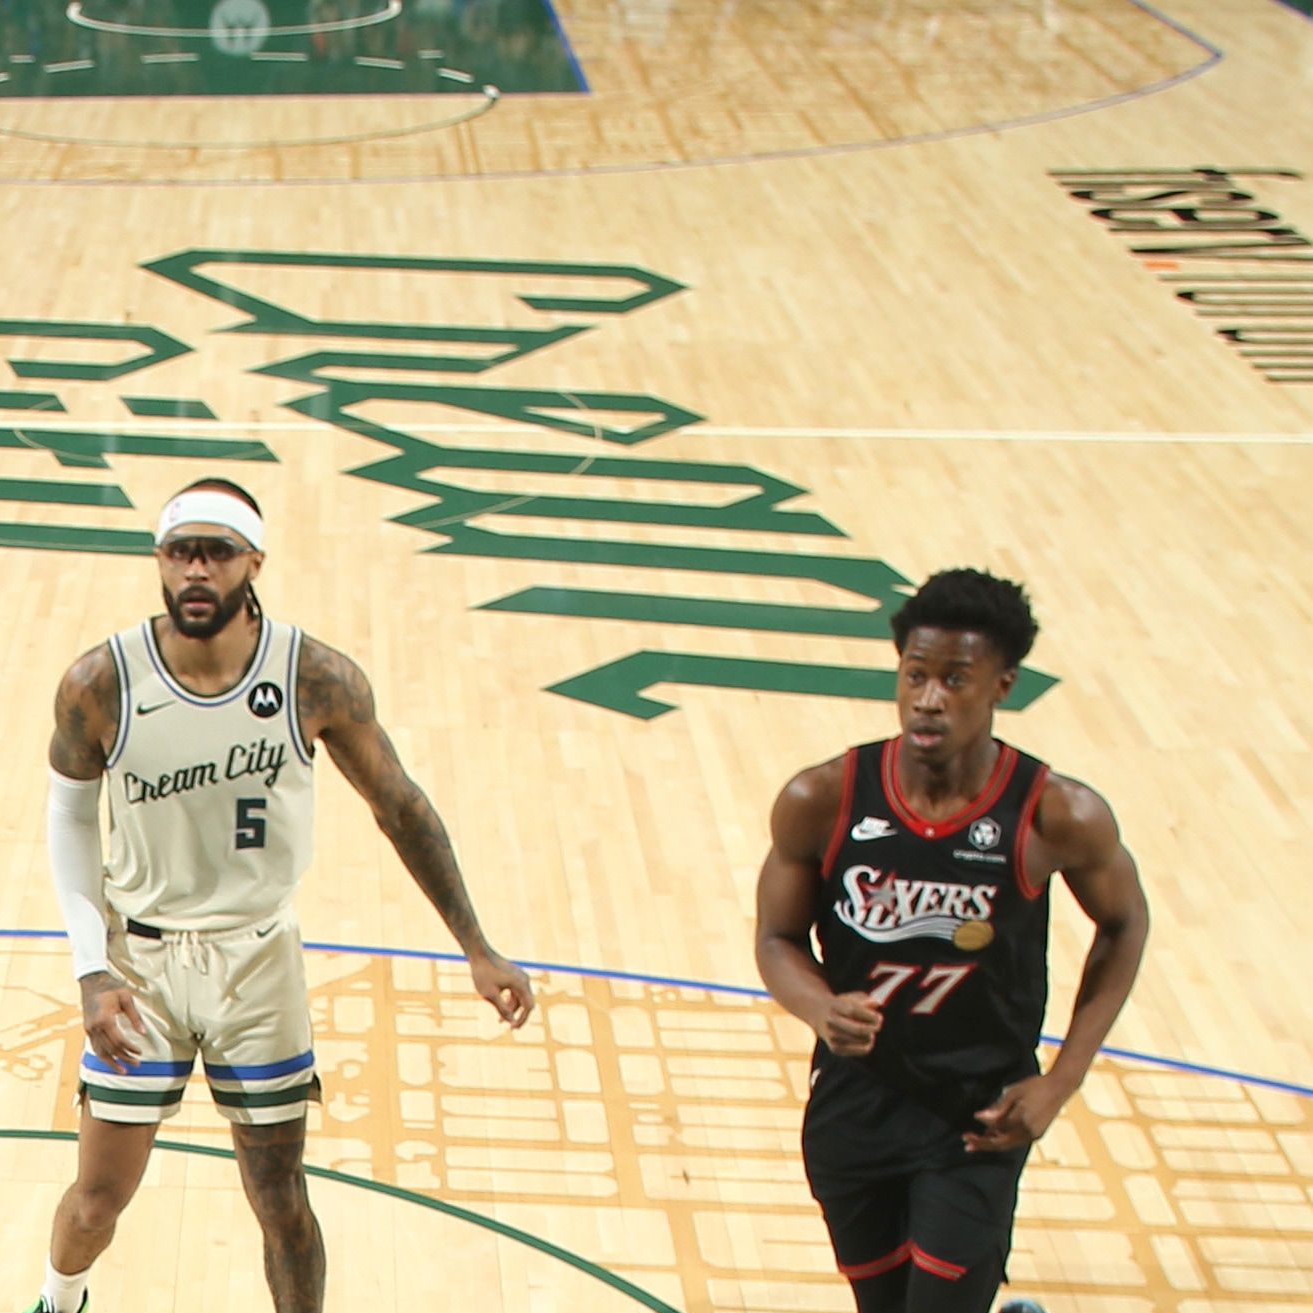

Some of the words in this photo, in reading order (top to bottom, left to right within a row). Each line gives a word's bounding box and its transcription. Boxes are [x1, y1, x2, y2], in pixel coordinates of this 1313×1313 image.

[139, 250, 1061, 720] Cream
[124, 761, 219, 805] Cream
[225, 737, 288, 788] City
[235, 796, 268, 850] 5
[866, 960, 977, 1015] 77
